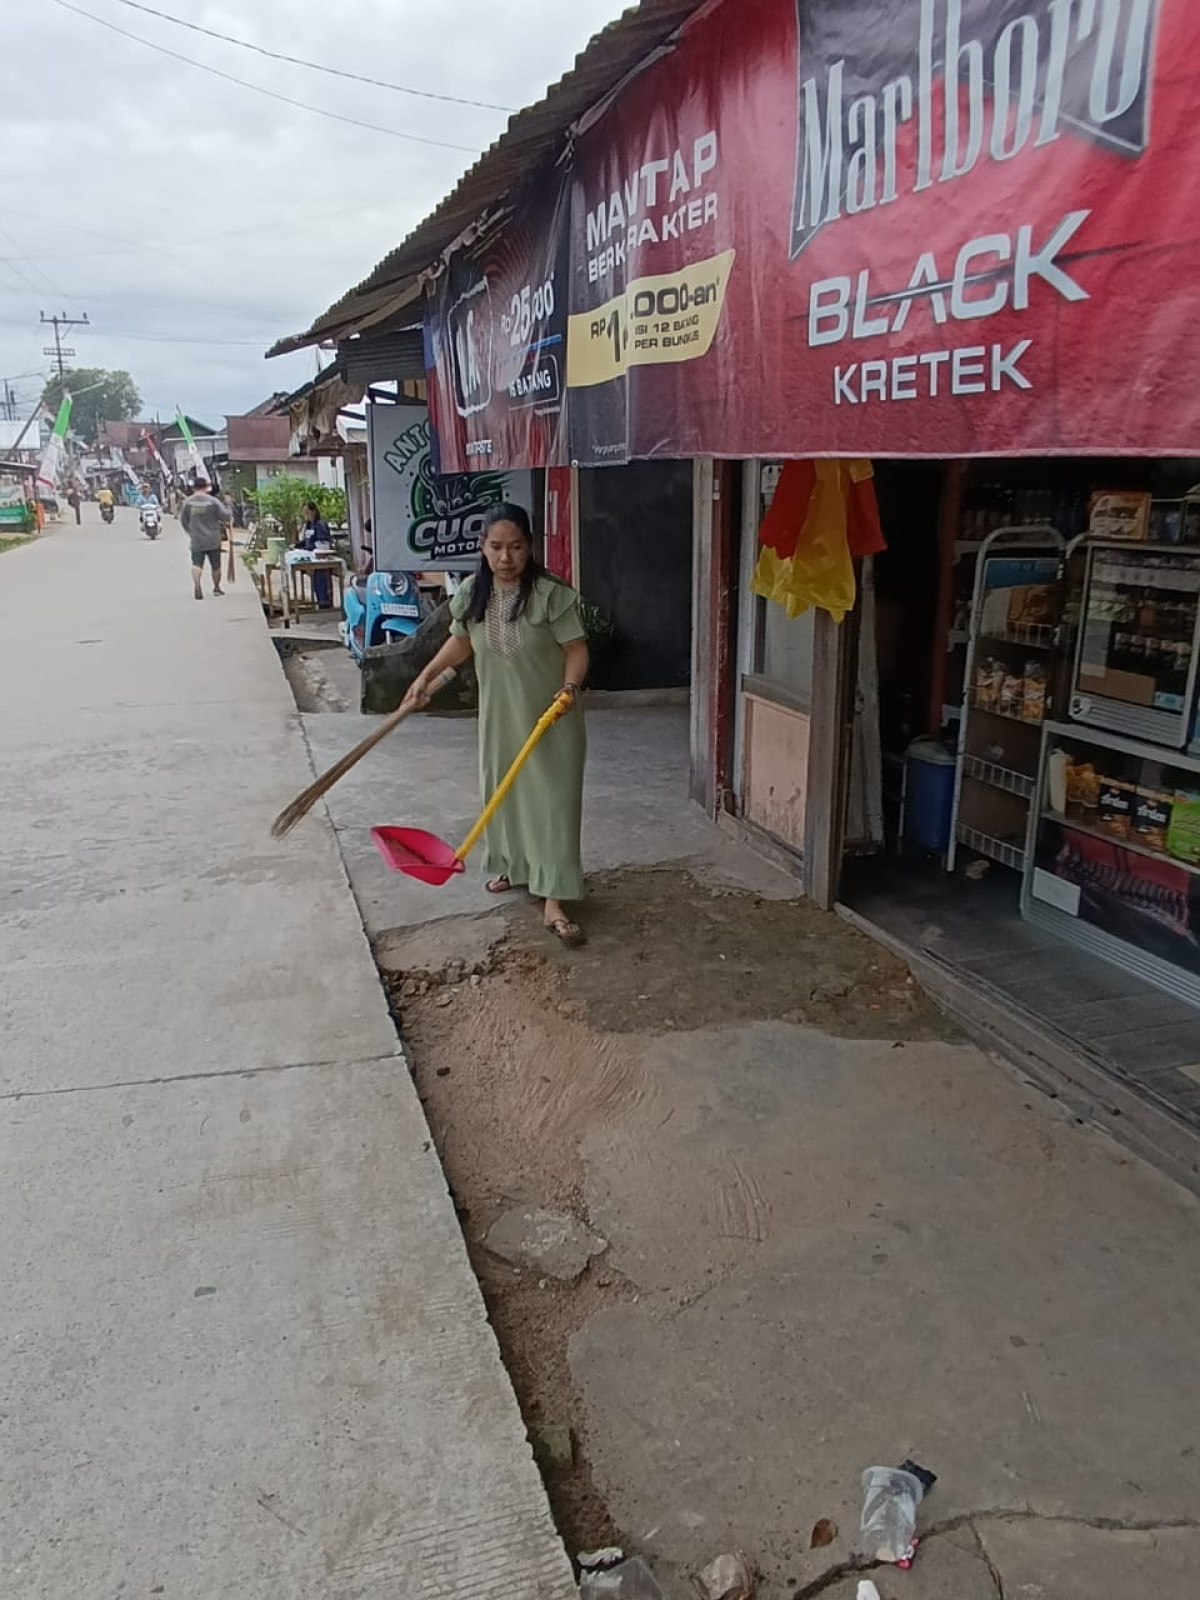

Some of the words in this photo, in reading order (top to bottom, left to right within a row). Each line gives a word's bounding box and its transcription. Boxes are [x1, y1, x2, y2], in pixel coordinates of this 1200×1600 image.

[796, 0, 1150, 231] Marlboro
[808, 209, 1092, 347] BLACK
[590, 318, 606, 340] RP
[653, 322, 670, 333] 12
[634, 338, 658, 350] PER
[516, 369, 552, 396] BATANG
[833, 339, 1033, 405] KRETEK
